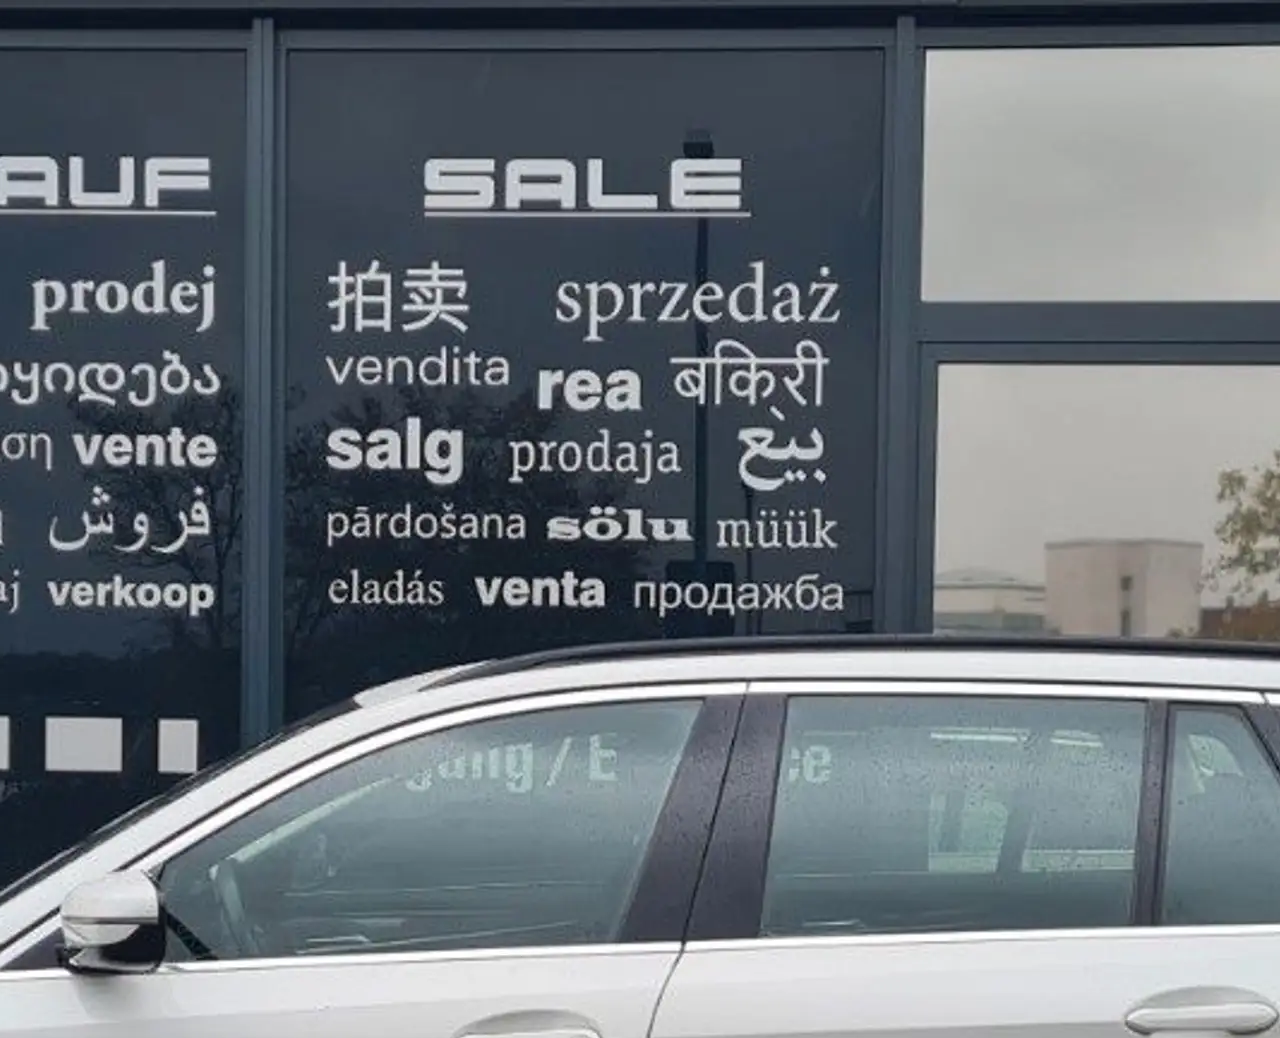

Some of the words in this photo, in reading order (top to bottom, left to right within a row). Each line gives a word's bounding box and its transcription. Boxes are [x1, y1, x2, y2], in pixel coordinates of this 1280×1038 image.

[423, 158, 742, 210] SALE
[30, 259, 216, 333] prodej
[327, 259, 470, 333] 拍卖
[555, 260, 841, 342] sprzedaż
[325, 345, 510, 386] vendita
[538, 369, 642, 412] rea
[71, 426, 218, 468] vente
[325, 416, 464, 485] salg
[508, 428, 682, 485] prodaja
[327, 502, 526, 547] pārdošana
[546, 505, 693, 542] sölu
[716, 507, 838, 549] müük
[47, 574, 215, 617] verkoop
[328, 568, 445, 606] eladás
[474, 570, 606, 608] venta
[634, 573, 844, 618] продажба
